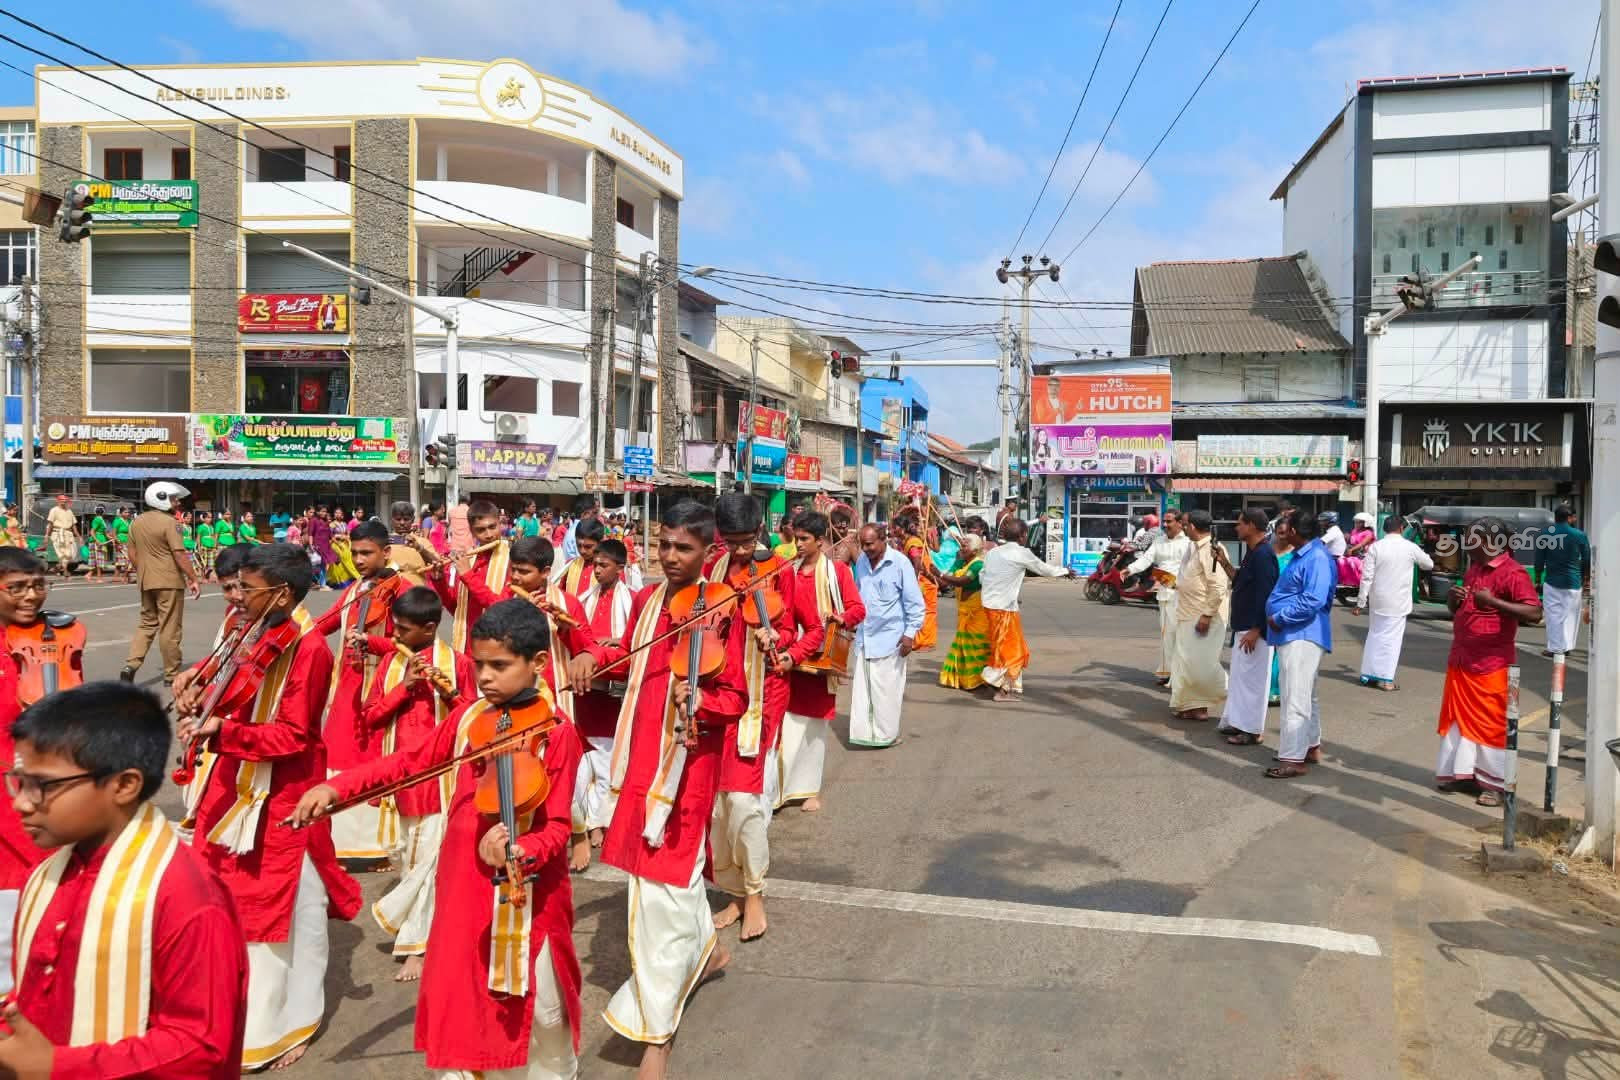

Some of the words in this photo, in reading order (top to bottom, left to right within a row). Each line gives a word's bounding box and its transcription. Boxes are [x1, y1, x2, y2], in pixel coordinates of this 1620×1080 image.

[89, 184, 112, 199] PM
[1089, 395, 1163, 410] HUTCH
[69, 424, 92, 440] PM
[474, 447, 548, 466] N.APPAR
[1471, 447, 1545, 456] OUTFIT
